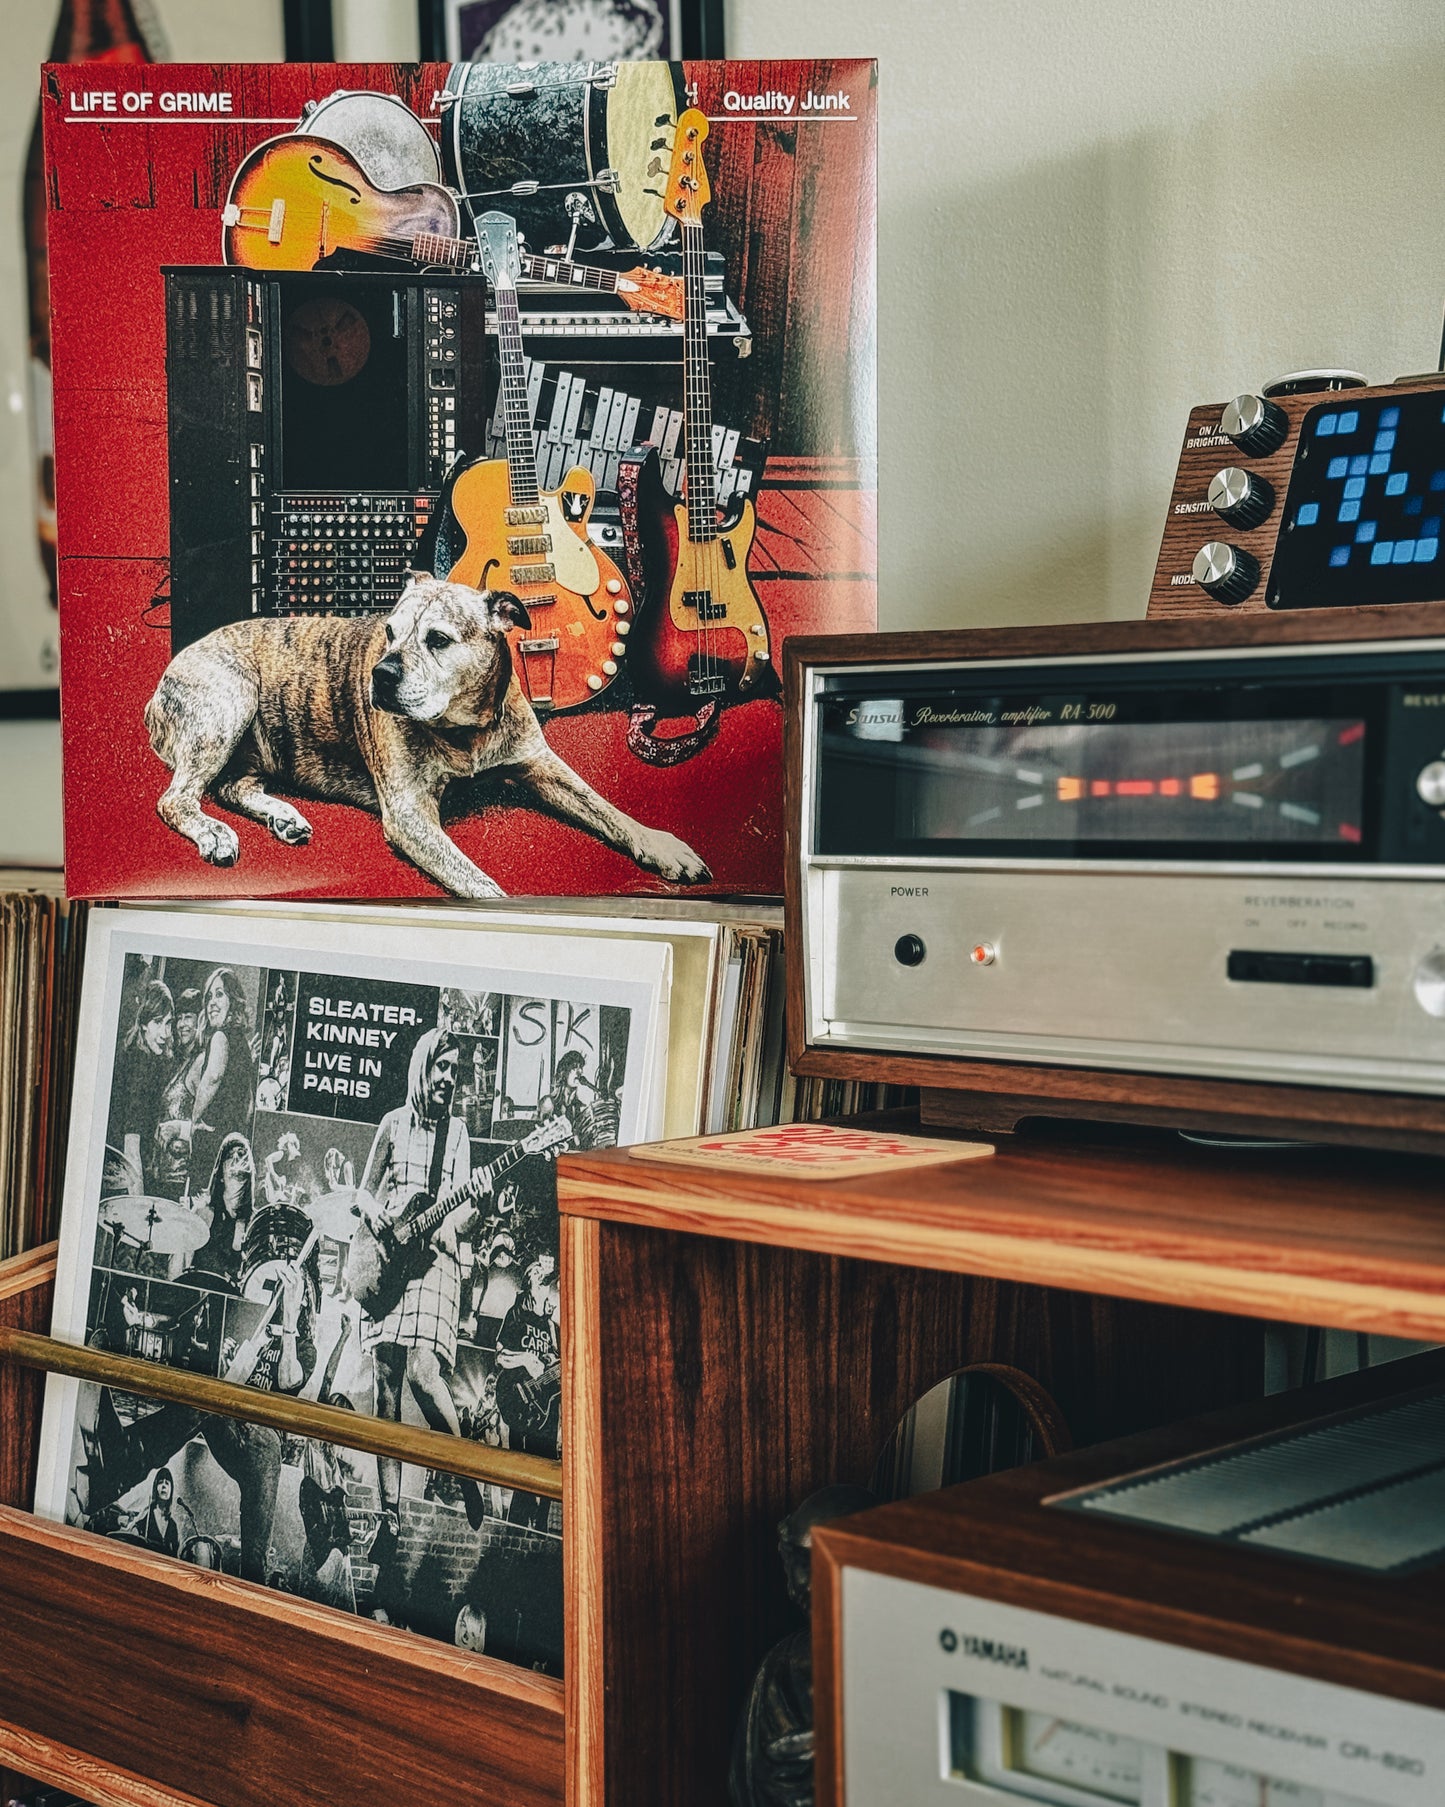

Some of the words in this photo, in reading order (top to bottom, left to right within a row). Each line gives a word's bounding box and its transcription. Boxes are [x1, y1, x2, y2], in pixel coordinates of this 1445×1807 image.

[70, 92, 117, 112] LIFE
[122, 92, 153, 112] OF
[159, 92, 233, 112] GRIME
[723, 91, 795, 115] Quality
[800, 90, 850, 110] Junk
[1187, 435, 1234, 449] BRIGHTNE
[1198, 425, 1212, 436] ON
[1171, 574, 1197, 586] MODE
[911, 706, 997, 726] Reverberation
[1001, 706, 1052, 726] amplifier
[1060, 703, 1117, 720] RA-500
[890, 886, 930, 897] POWER
[1244, 895, 1355, 910] REVERBERATION
[309, 996, 423, 1026] SLEATER-
[306, 1021, 398, 1049] KINNEY
[304, 1050, 352, 1073] LIVE
[358, 1058, 382, 1078] IN
[303, 1073, 371, 1099] PARIS
[962, 1634, 1030, 1671] YAMAHA
[1180, 1702, 1243, 1729] STEREO
